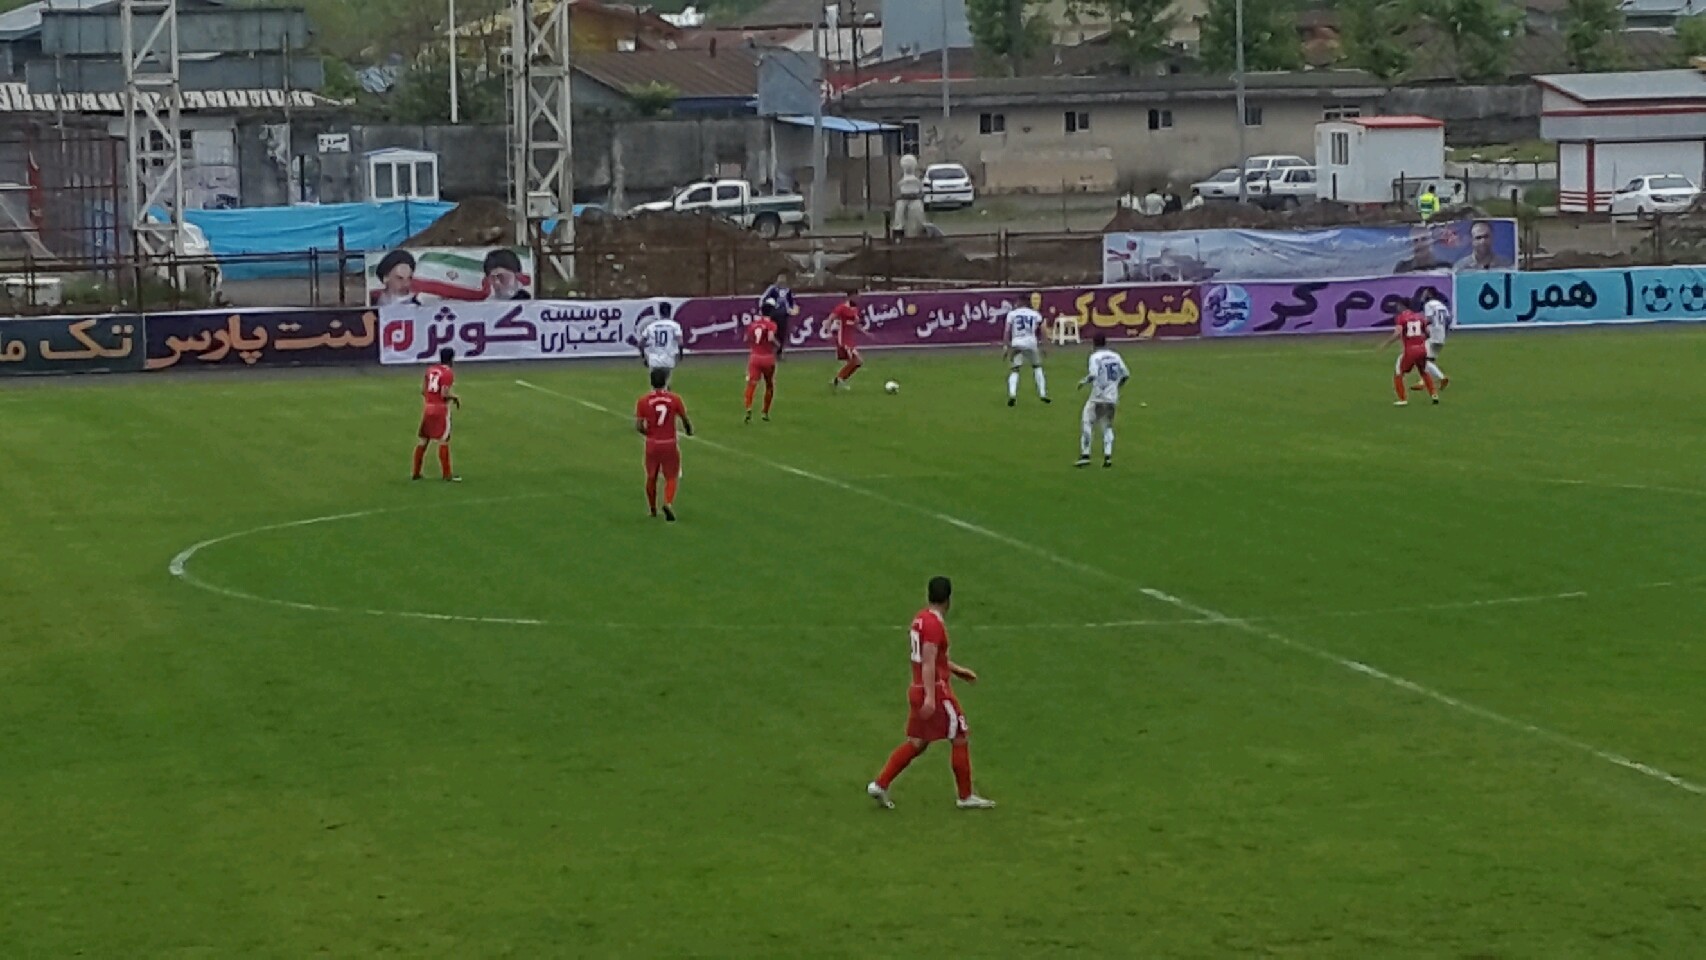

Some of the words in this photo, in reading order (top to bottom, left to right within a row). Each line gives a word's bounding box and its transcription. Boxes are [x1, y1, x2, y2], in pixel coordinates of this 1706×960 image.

[1478, 273, 1597, 322] همراه
[541, 307, 622, 327] موسسه
[862, 298, 905, 331] امتیاز
[917, 308, 956, 338] باش
[1016, 315, 1033, 331] 34
[39, 319, 134, 359] تک
[146, 315, 268, 369] پارس
[275, 312, 375, 349] لنت
[417, 305, 537, 359] کوثر
[541, 324, 622, 352] اعتباری
[654, 330, 668, 347] 10
[655, 405, 667, 426] 7
